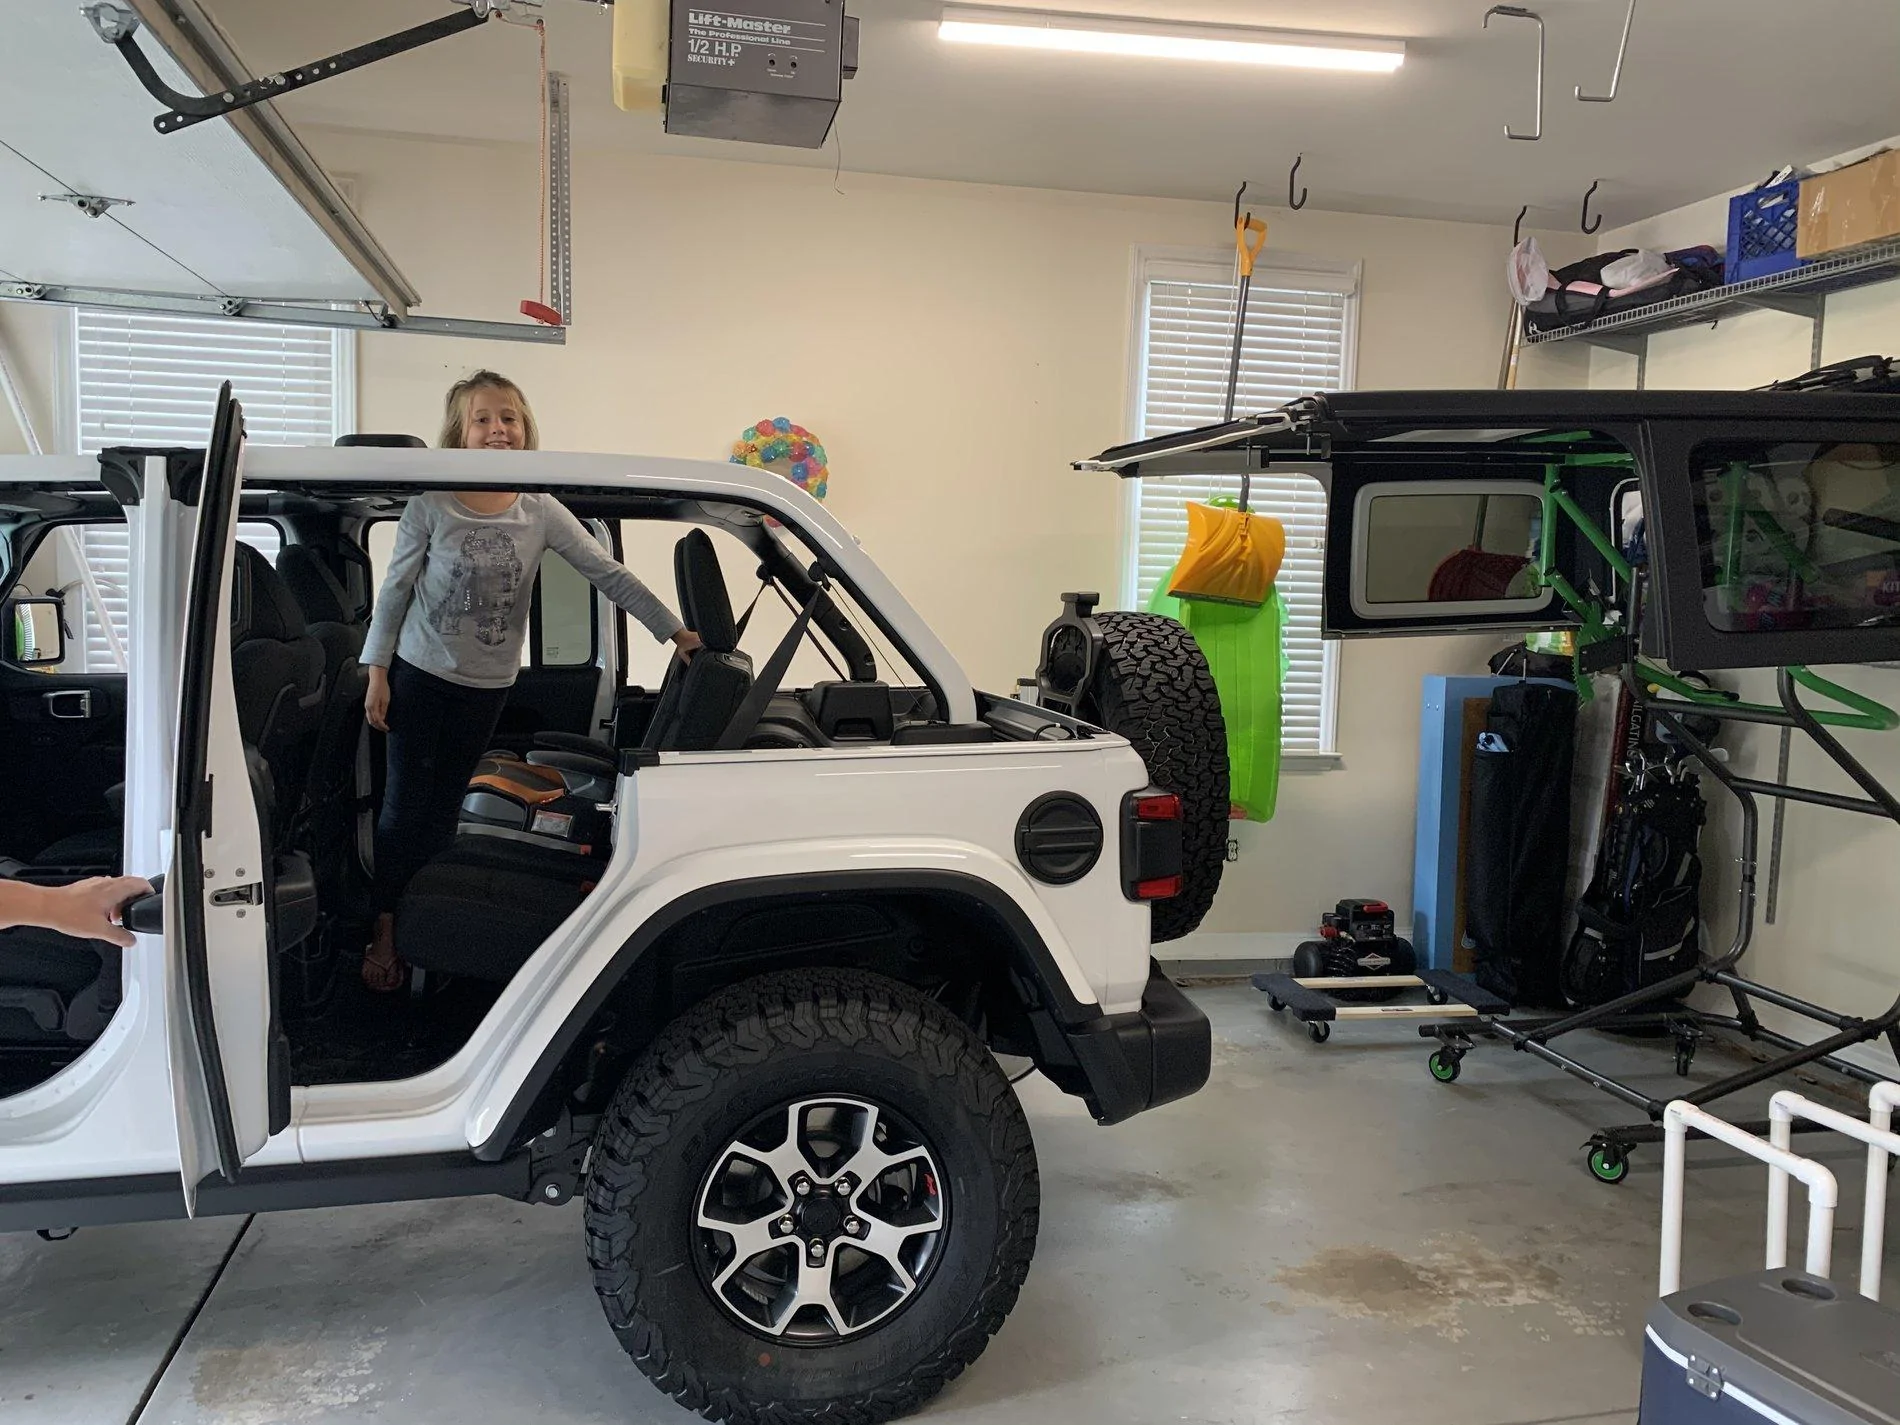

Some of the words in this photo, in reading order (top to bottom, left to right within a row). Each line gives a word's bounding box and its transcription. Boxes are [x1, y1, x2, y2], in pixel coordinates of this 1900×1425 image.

[689, 12, 791, 34] Lift-Master
[689, 28, 706, 36] The
[708, 30, 769, 43] Professional
[771, 37, 791, 45] Line
[688, 39, 709, 54] 1/2
